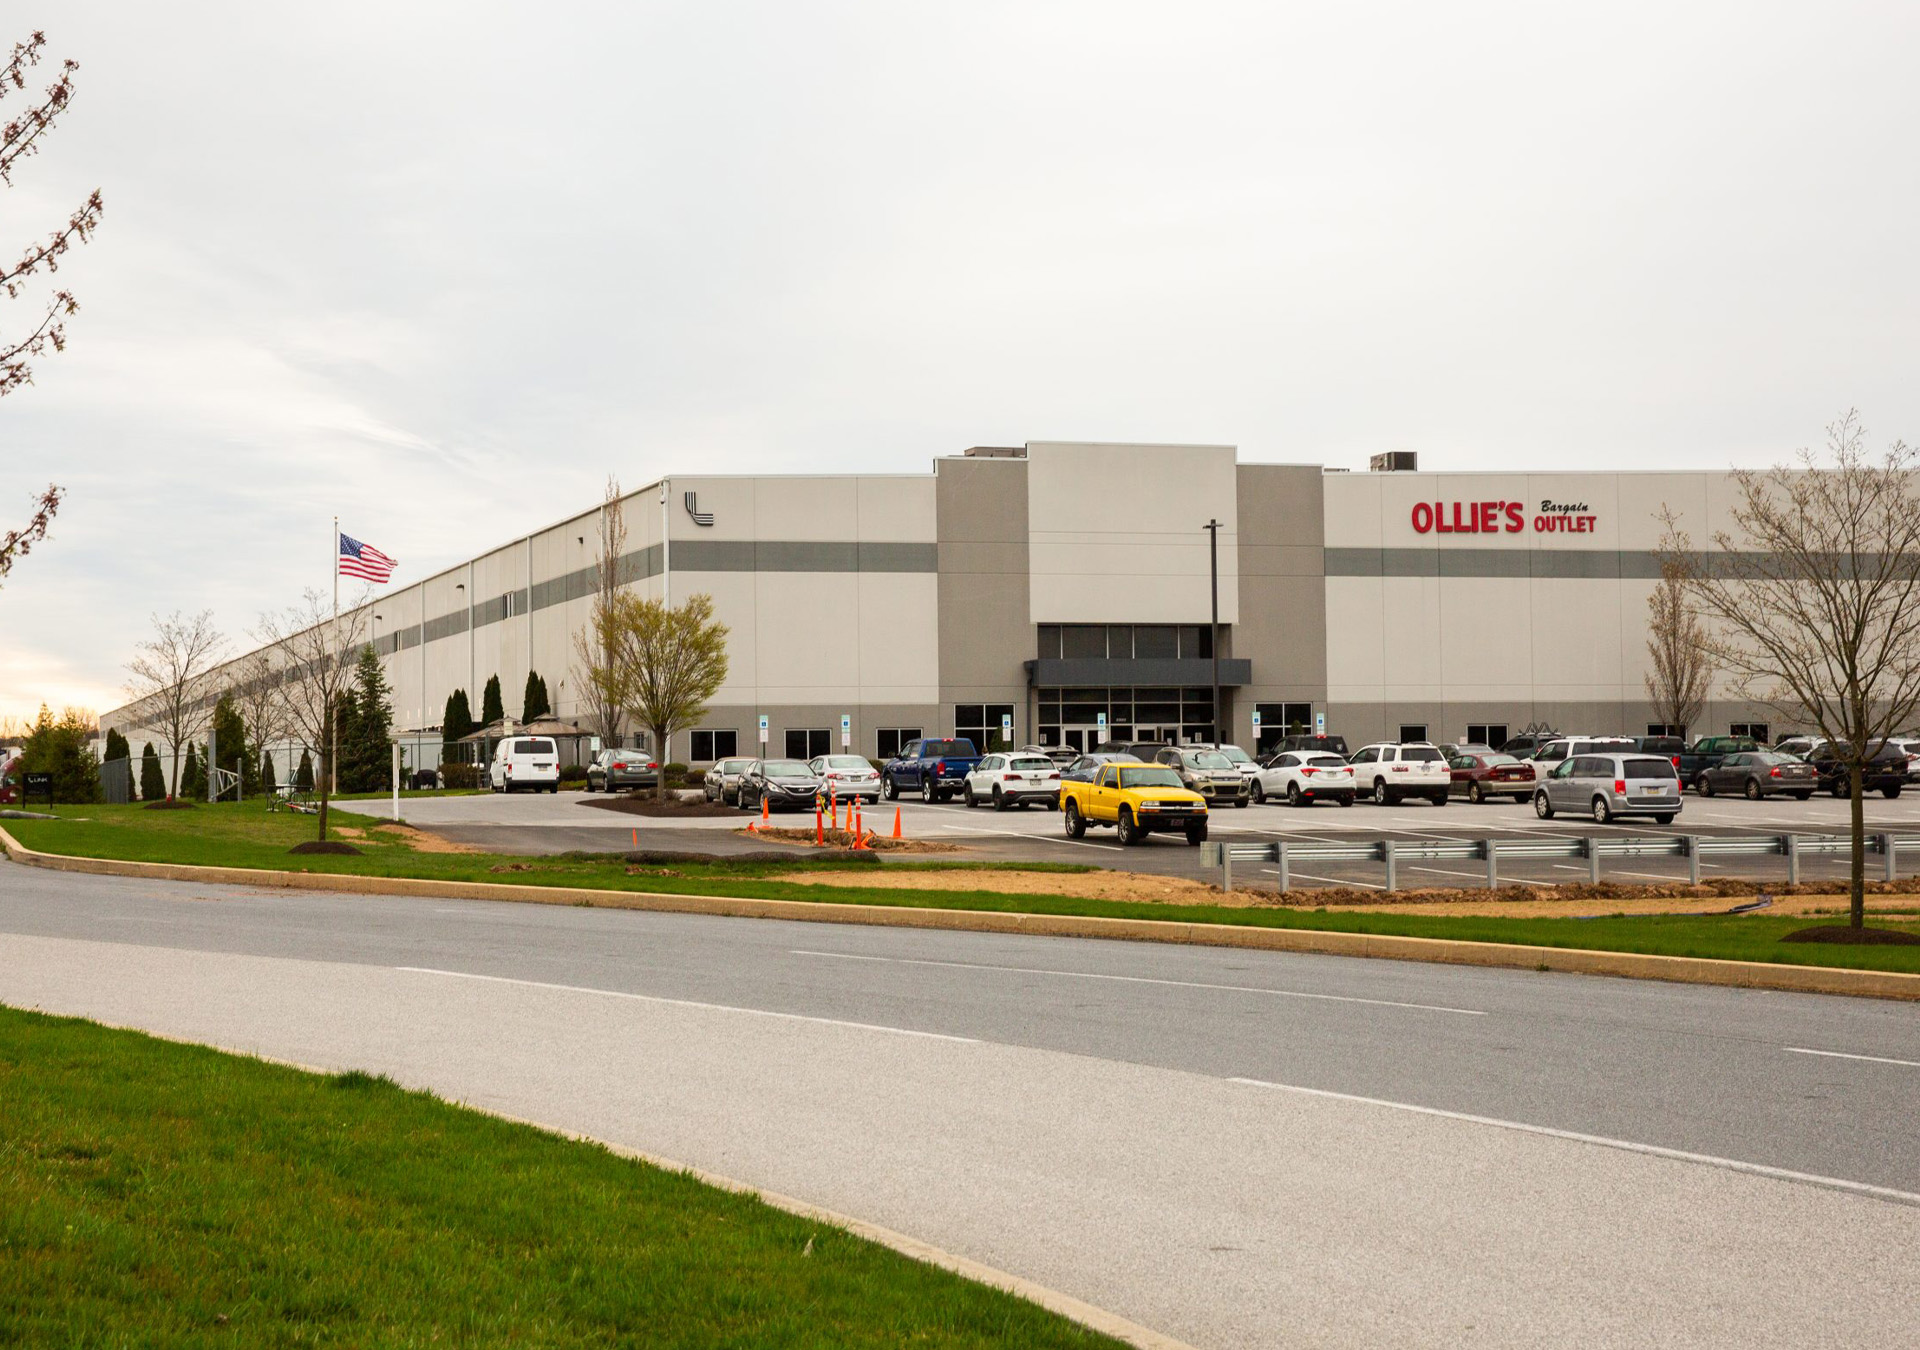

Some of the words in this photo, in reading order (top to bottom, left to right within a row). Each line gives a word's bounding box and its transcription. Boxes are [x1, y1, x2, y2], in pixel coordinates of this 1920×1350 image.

[1541, 500, 1589, 516] Bargain
[1411, 501, 1525, 534] OLLIE'S
[1534, 515, 1597, 532] OUTLET
